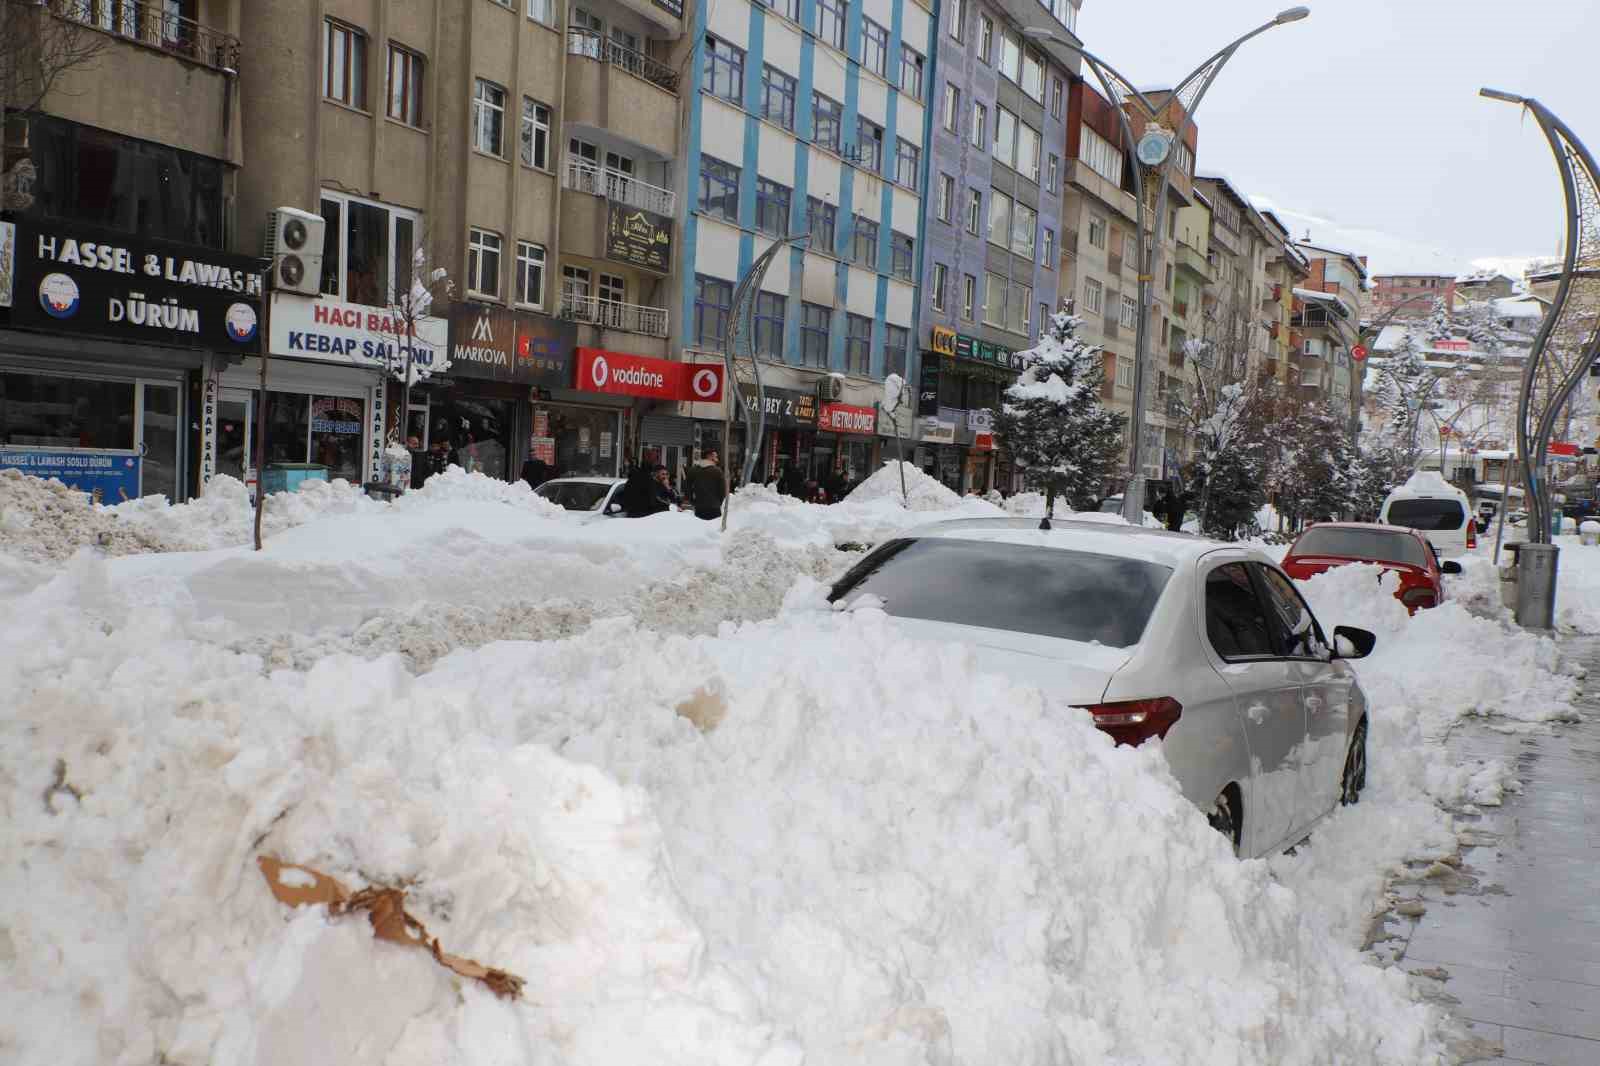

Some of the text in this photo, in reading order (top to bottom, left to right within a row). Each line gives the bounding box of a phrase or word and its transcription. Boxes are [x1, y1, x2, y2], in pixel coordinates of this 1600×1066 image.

[38, 233, 136, 275] HASSEL
[143, 254, 161, 277] &
[108, 292, 200, 333] DÜRÜM
[314, 304, 362, 328] HACI
[288, 331, 357, 356] KEBAP
[454, 344, 507, 365] MARKOVA
[612, 366, 663, 388] vodafone
[205, 382, 215, 437] KEBAP
[784, 401, 793, 416] 2
[831, 410, 853, 430] METRO
